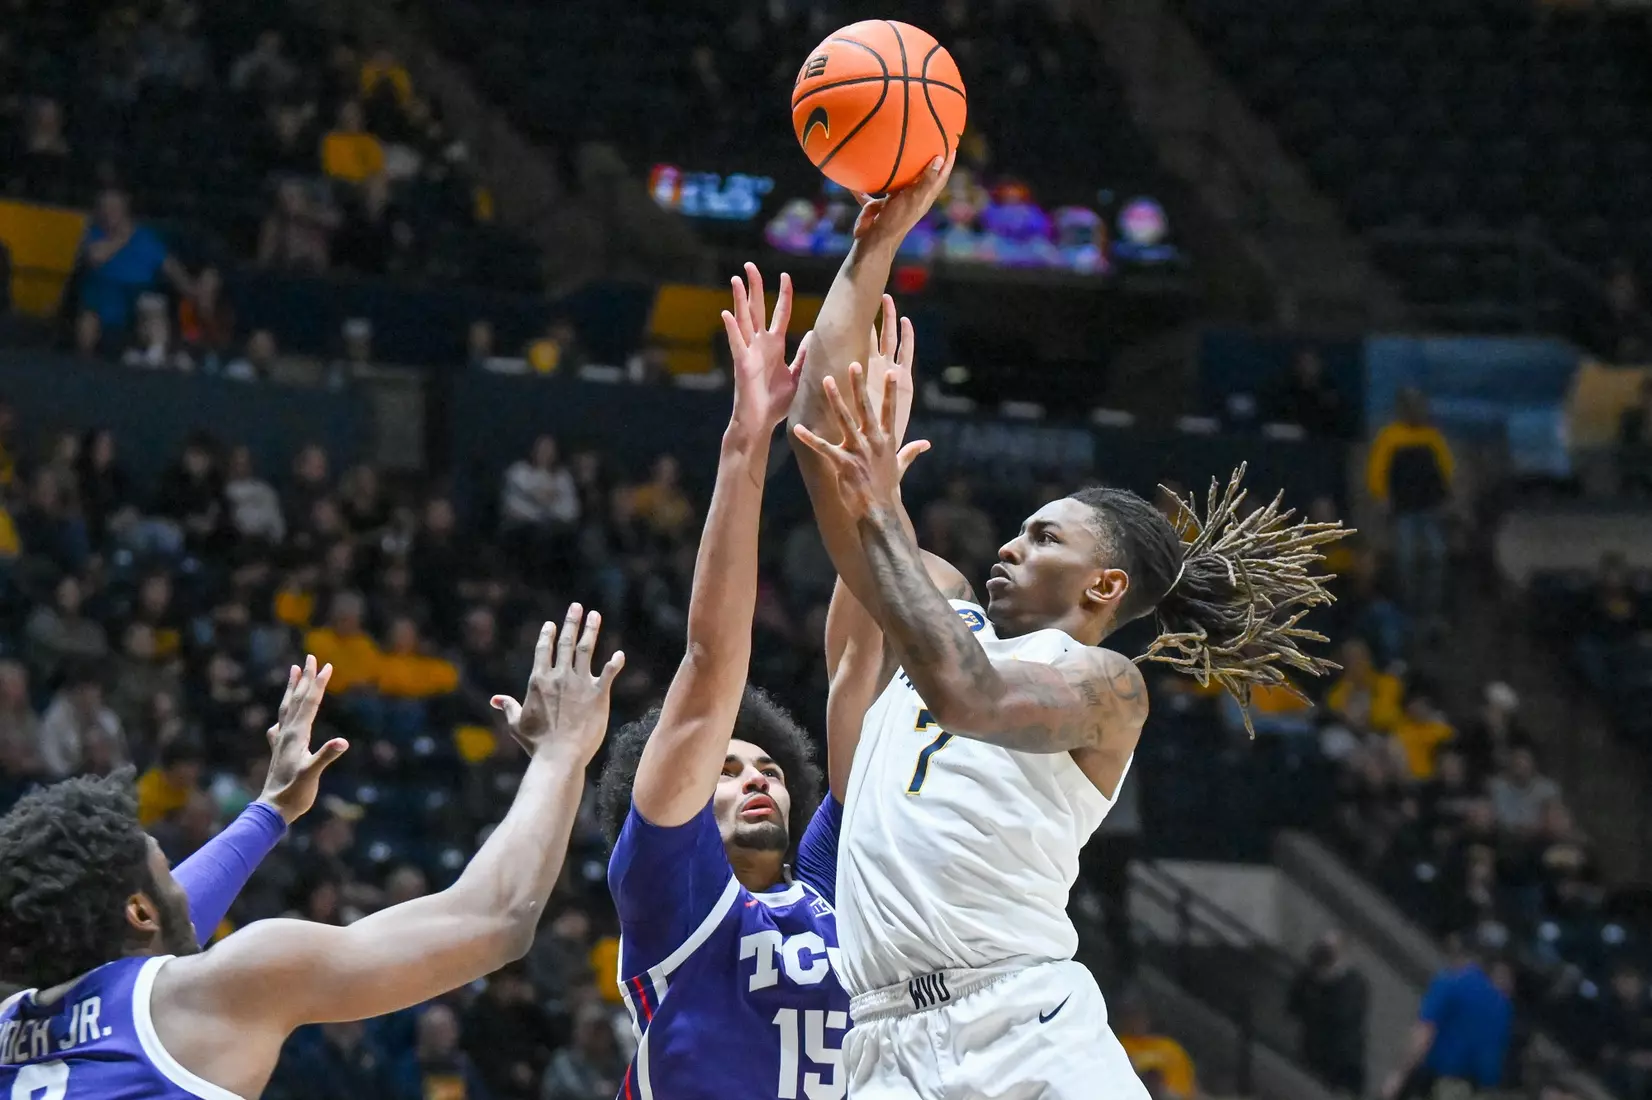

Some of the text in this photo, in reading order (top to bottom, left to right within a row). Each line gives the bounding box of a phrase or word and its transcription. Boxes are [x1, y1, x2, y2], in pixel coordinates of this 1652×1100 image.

[904, 706, 955, 796] 7
[59, 996, 112, 1051] JR.
[908, 972, 951, 1010] WVU
[772, 1007, 848, 1100] 15
